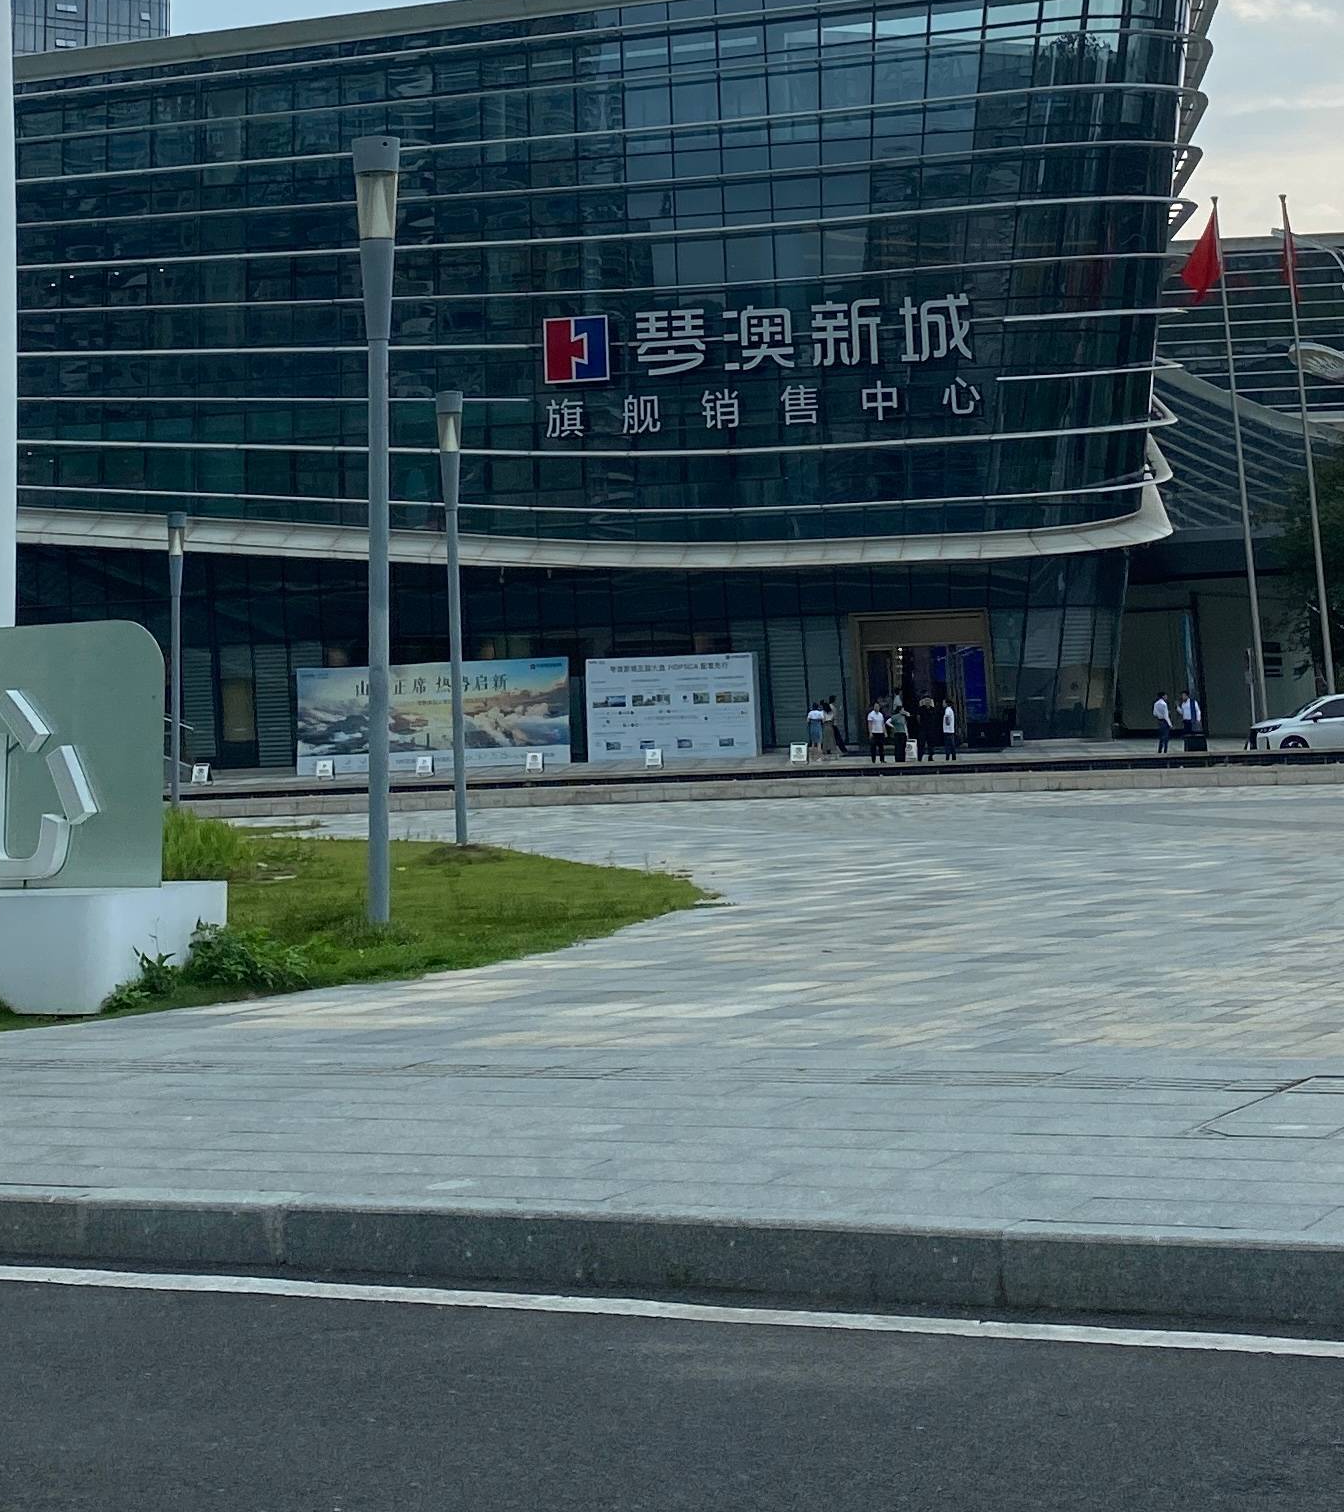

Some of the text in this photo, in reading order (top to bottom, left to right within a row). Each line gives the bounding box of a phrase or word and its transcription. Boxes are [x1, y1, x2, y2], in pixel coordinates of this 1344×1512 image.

[635, 293, 974, 376] 琴澳新城
[545, 377, 981, 438] 旗舰销售中心
